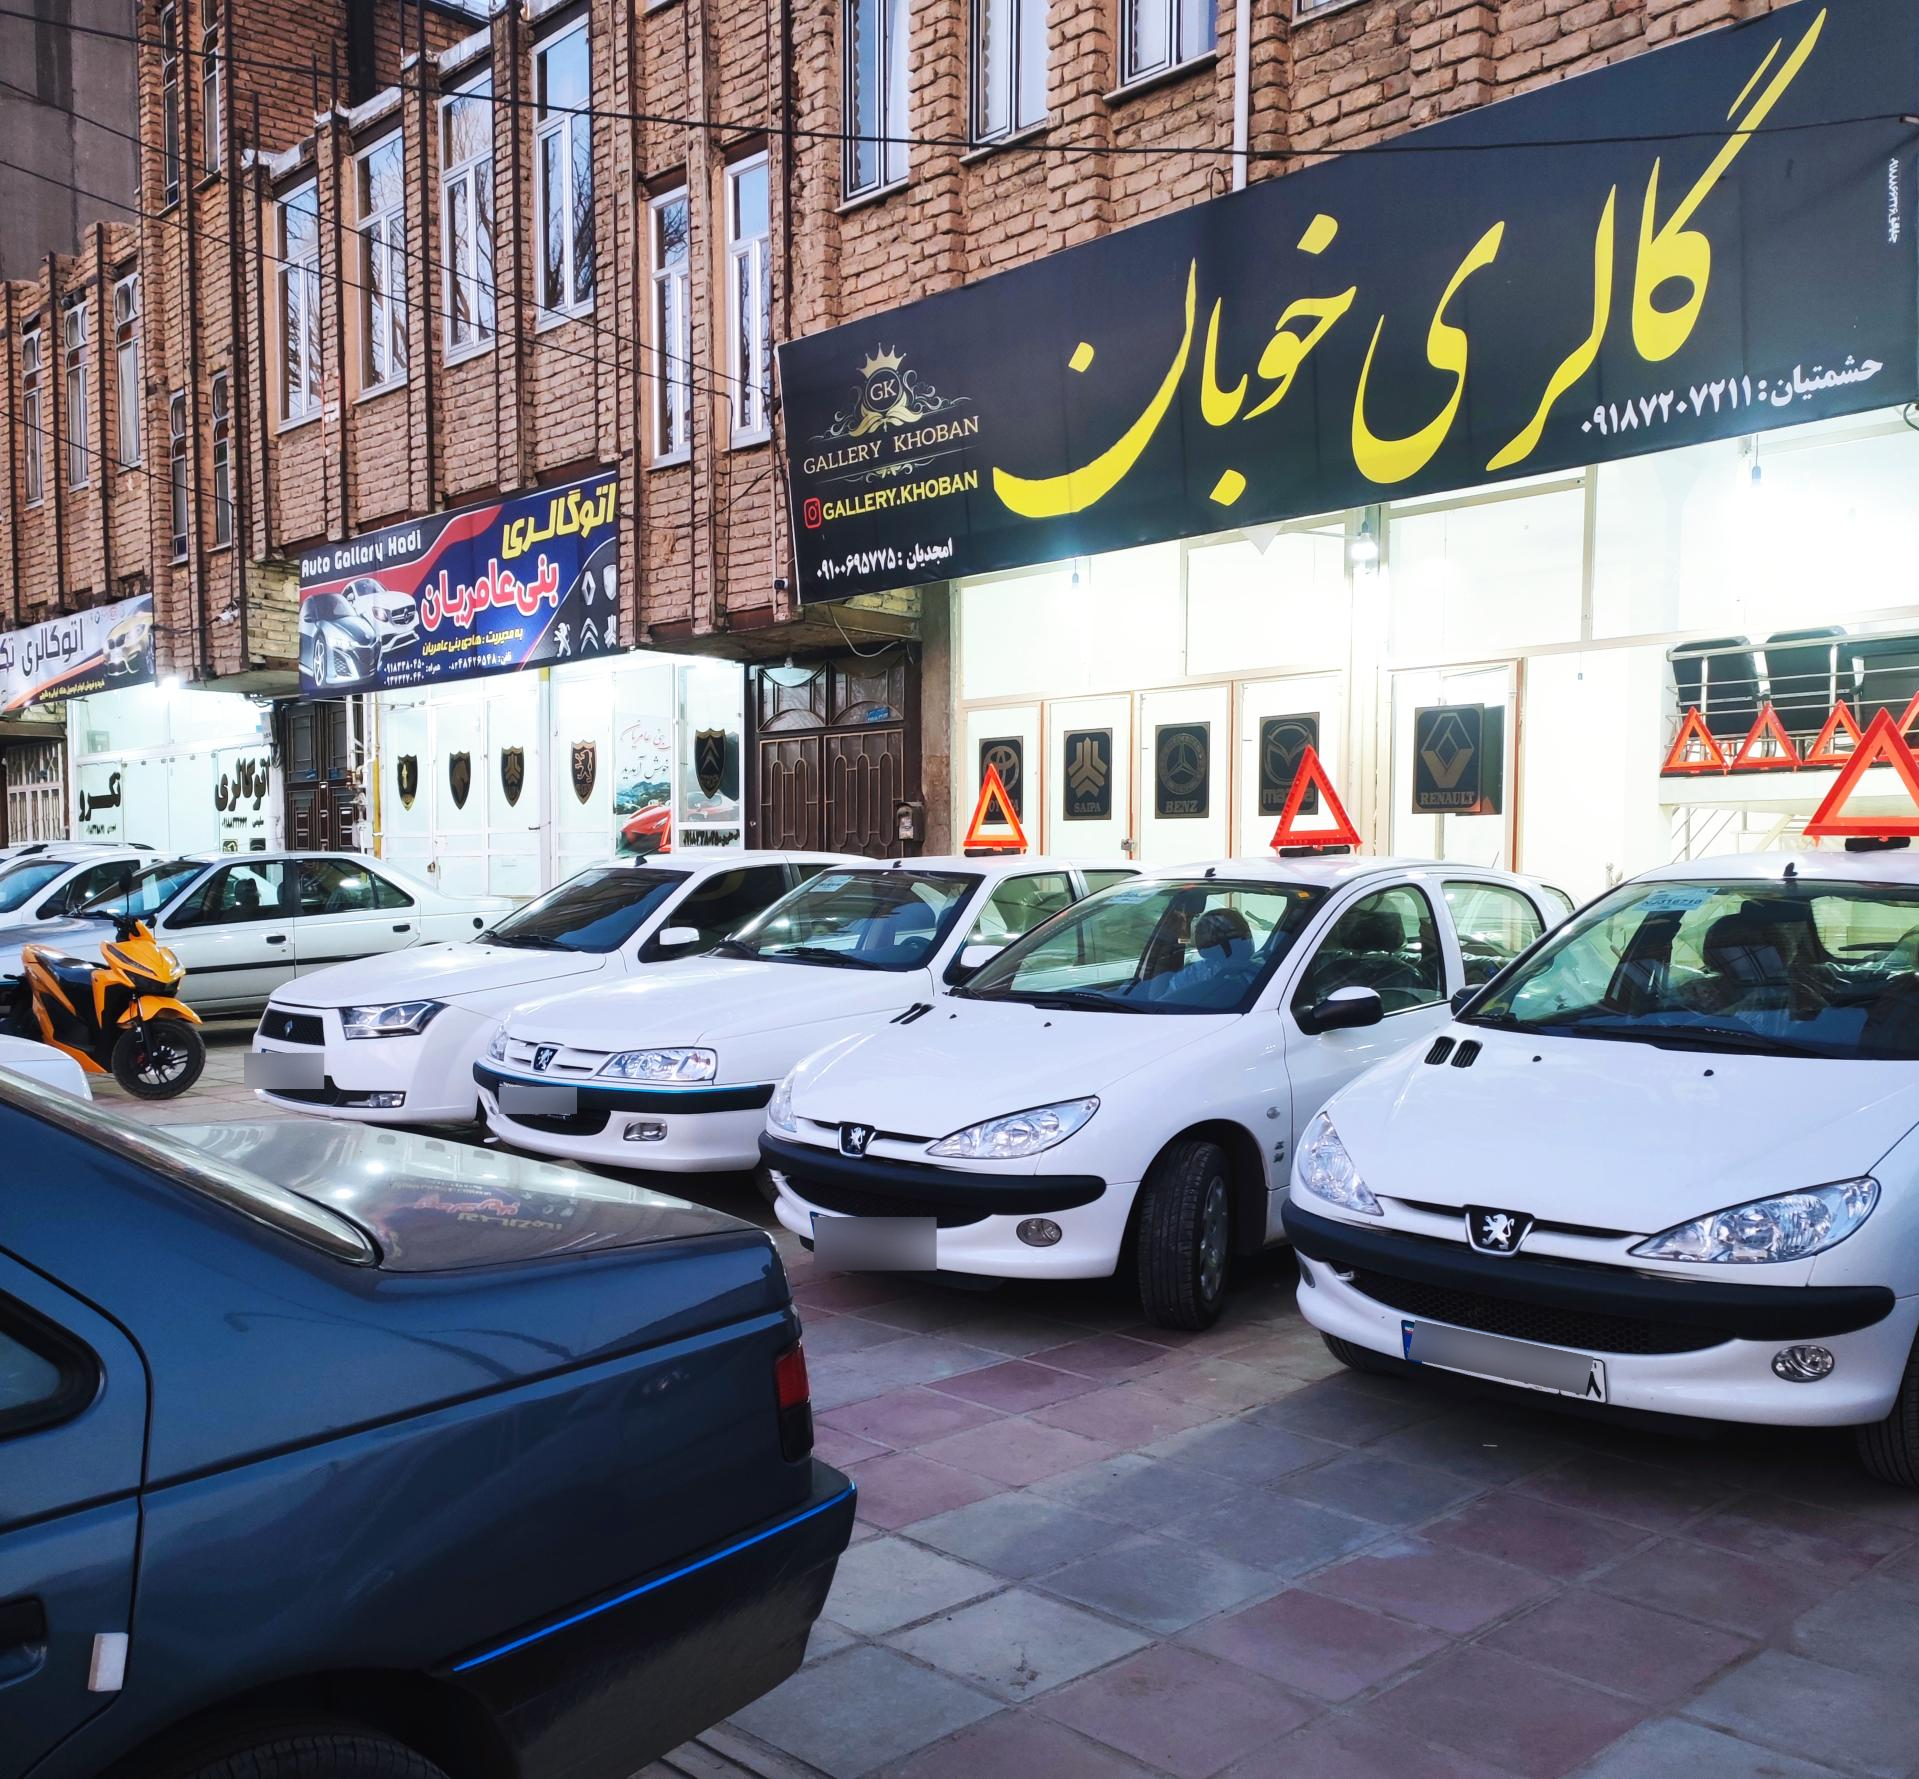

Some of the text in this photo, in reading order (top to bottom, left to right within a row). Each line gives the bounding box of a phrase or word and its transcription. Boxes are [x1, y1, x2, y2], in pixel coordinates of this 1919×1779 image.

[993, 12, 1824, 517] گالری خوبان
[869, 378, 897, 401] GK
[1581, 374, 1752, 435] ۰۹۱۸۷۲۰۷۲۱۱
[803, 416, 979, 474] GALLERY KHOBAN
[822, 470, 978, 520] GALLERY.KHOBAN
[501, 482, 617, 560] اتوگالری
[301, 558, 331, 578] Auto
[388, 529, 422, 557] Hadi
[816, 547, 896, 580] ۰۹۱۰۰۶۹۵۷۷۵
[1073, 802, 1102, 813] SAIPA
[1165, 800, 1199, 813] BENZ
[1420, 791, 1476, 805] RENAULT
